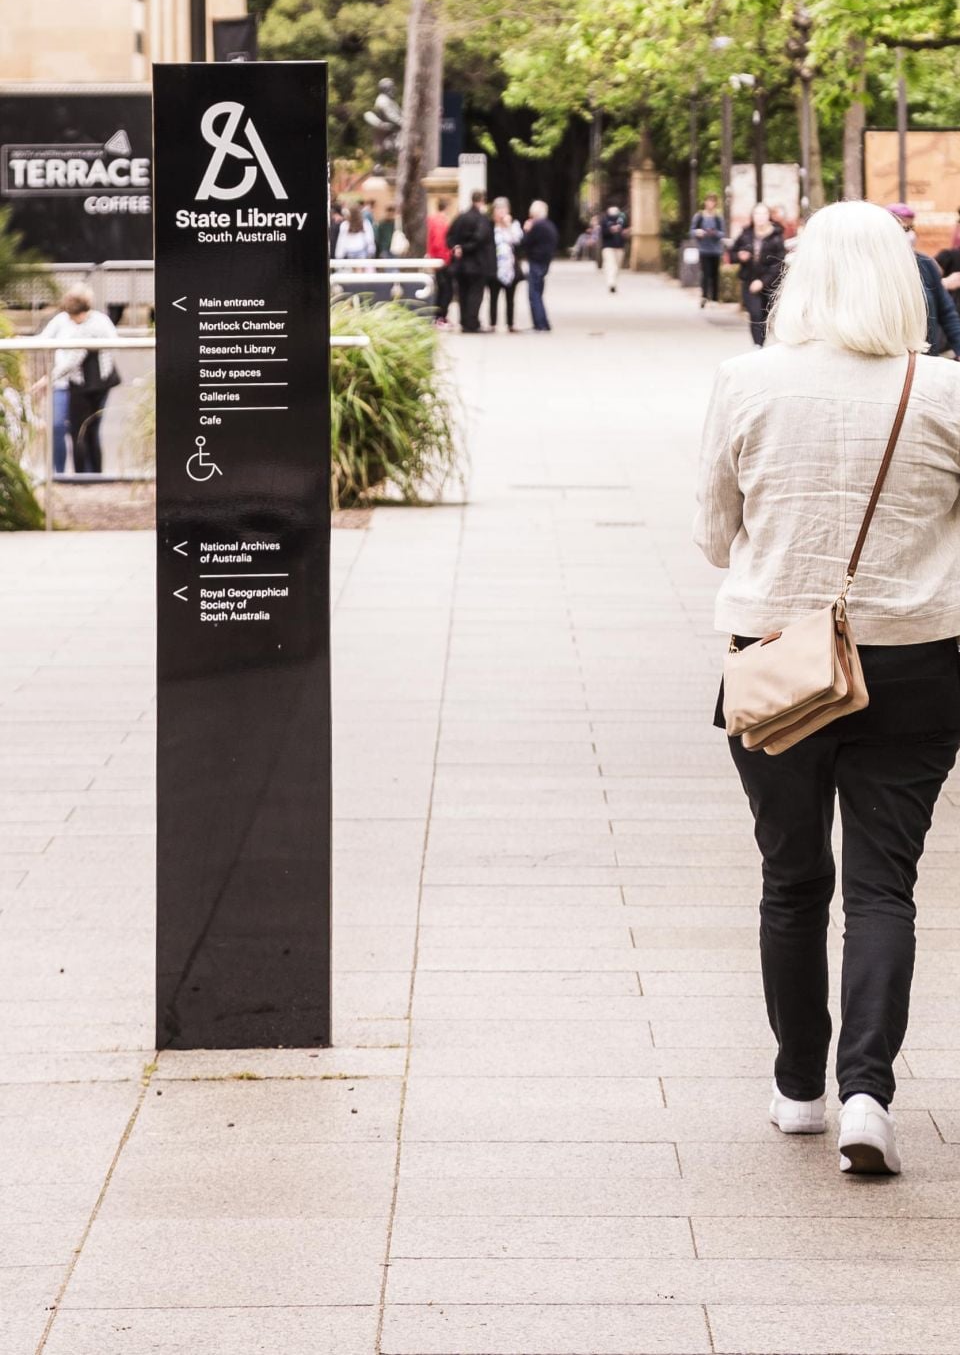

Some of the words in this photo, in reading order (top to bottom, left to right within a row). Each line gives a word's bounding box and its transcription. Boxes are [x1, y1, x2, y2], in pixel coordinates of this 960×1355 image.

[9, 158, 150, 187] TERRACE
[84, 196, 151, 214] COFFEE
[175, 209, 231, 228] State
[236, 208, 308, 230] Library
[198, 232, 233, 242] South
[235, 231, 287, 242] Australia
[199, 298, 222, 307] Main
[224, 299, 265, 307] entrance
[199, 321, 240, 330] Mortlock
[242, 321, 285, 330] Chamber
[199, 345, 242, 354] Research
[244, 344, 276, 355] Library
[199, 368, 227, 379] Study
[229, 369, 262, 378] spaces
[199, 392, 240, 401] Galleries
[199, 415, 222, 425] Cafe
[200, 542, 239, 551] National
[240, 541, 280, 550] Archives
[200, 554, 210, 563] of
[212, 553, 252, 563] Australia
[200, 588, 225, 598] Royal
[227, 587, 288, 599] Geographical
[200, 600, 235, 610] Society
[237, 599, 247, 609] of
[200, 612, 228, 621] South
[230, 611, 270, 620] Australia
